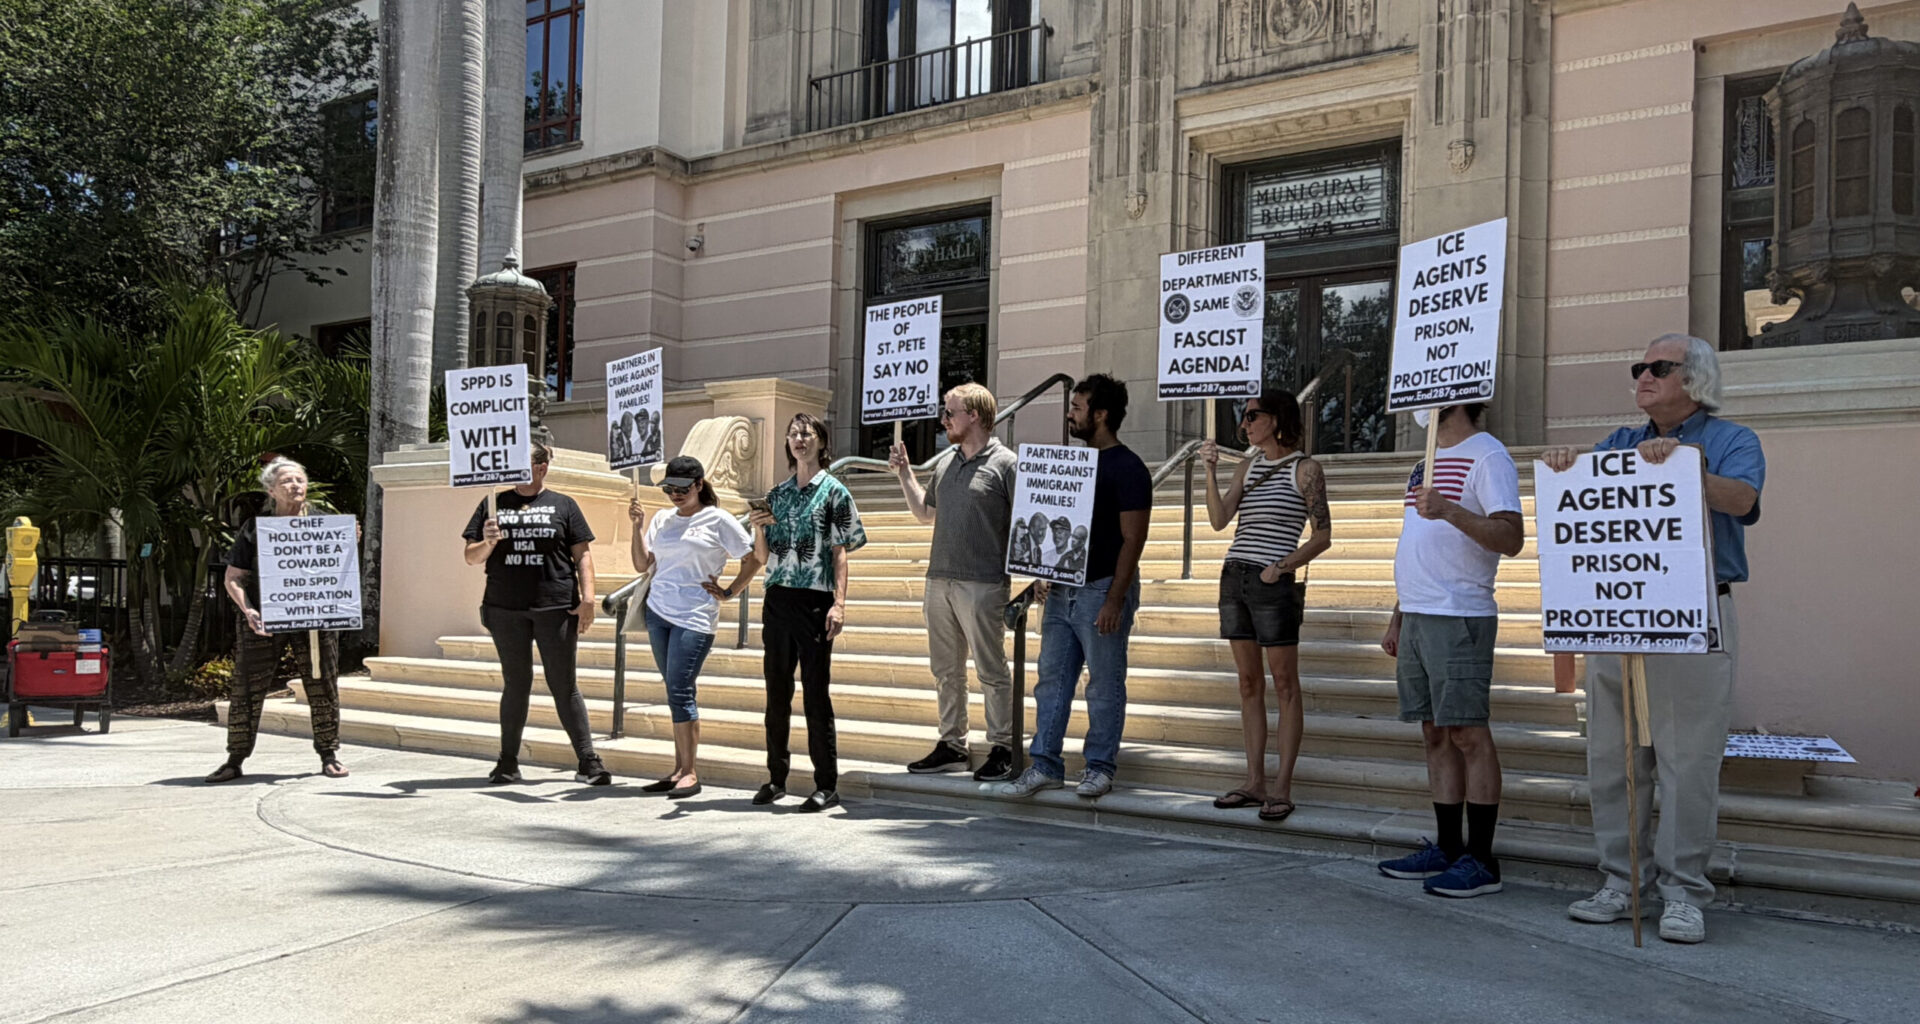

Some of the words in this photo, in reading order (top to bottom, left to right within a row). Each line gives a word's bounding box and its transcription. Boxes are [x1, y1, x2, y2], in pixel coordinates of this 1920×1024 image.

[1257, 175, 1369, 205] MUNICIPAL
[1262, 196, 1365, 225] BUILDING
[935, 243, 975, 261] HALL
[1437, 232, 1465, 257] ICE
[1178, 245, 1246, 266] DIFFERENT
[1163, 269, 1262, 291] DEPARTMENTS,
[1413, 255, 1487, 290] AGENTS
[1194, 297, 1229, 312] SAME
[1409, 283, 1488, 317] DESERVE
[869, 308, 889, 322] THE
[893, 301, 938, 319] PEOPLE
[894, 322, 910, 335] OF
[1415, 316, 1473, 341] PRISON,
[877, 342, 894, 355] ST.
[898, 338, 925, 352] PETE
[1174, 328, 1247, 348] FASCIST
[1427, 342, 1458, 362] NOT
[612, 356, 646, 373] PARTNERS
[648, 352, 655, 362] IN
[873, 361, 901, 379] SAY
[906, 359, 928, 375] NO
[1168, 355, 1249, 375] AGENDA!
[461, 376, 496, 390] SPPD
[500, 374, 513, 387] IS
[609, 374, 629, 387] CRIME
[630, 364, 659, 381] AGAINST
[1394, 360, 1491, 389] PROTECTION!
[615, 380, 653, 398] IMMIGRANT
[866, 390, 884, 405] TO
[889, 384, 930, 403] 287g!
[1160, 383, 1246, 394] www.End287g.com
[1391, 385, 1478, 404] www.End287g.com
[451, 398, 525, 416] COMPLICIT
[619, 394, 650, 410] FAMILIES!
[461, 425, 516, 449] WITH
[471, 449, 509, 472] ICE!
[1027, 447, 1076, 461] PARTNERS
[1079, 451, 1089, 462] IN
[1019, 462, 1047, 474] CRIME
[1050, 465, 1094, 478] AGAINST
[1593, 452, 1636, 477] ICE
[1027, 478, 1083, 493] IMMIGRANT
[1030, 493, 1075, 508] FAMILIES!
[1557, 483, 1676, 512] AGENTS
[290, 518, 324, 528] CHIEF
[499, 515, 519, 525] NO
[523, 514, 551, 524] KKK
[269, 531, 346, 542] HOLLOWAY:
[512, 528, 556, 538] FASCIST
[1555, 518, 1682, 544] DESERVE
[274, 545, 312, 555] DON'T
[317, 545, 330, 554] BE
[334, 544, 342, 553] A
[514, 541, 535, 551] USA
[278, 558, 340, 569] COWARD!
[505, 554, 522, 565] NO
[525, 554, 544, 565] ICE
[1572, 553, 1668, 574] PRISON,
[284, 578, 306, 587] END
[309, 577, 338, 586] SPPD
[1596, 582, 1645, 600] NOT
[270, 591, 352, 601] COOPERATION
[285, 607, 314, 615] WITH
[318, 605, 338, 614] ICE!
[1546, 609, 1702, 628] PROTECTION!
[1545, 634, 1685, 648] www.End287g.com
